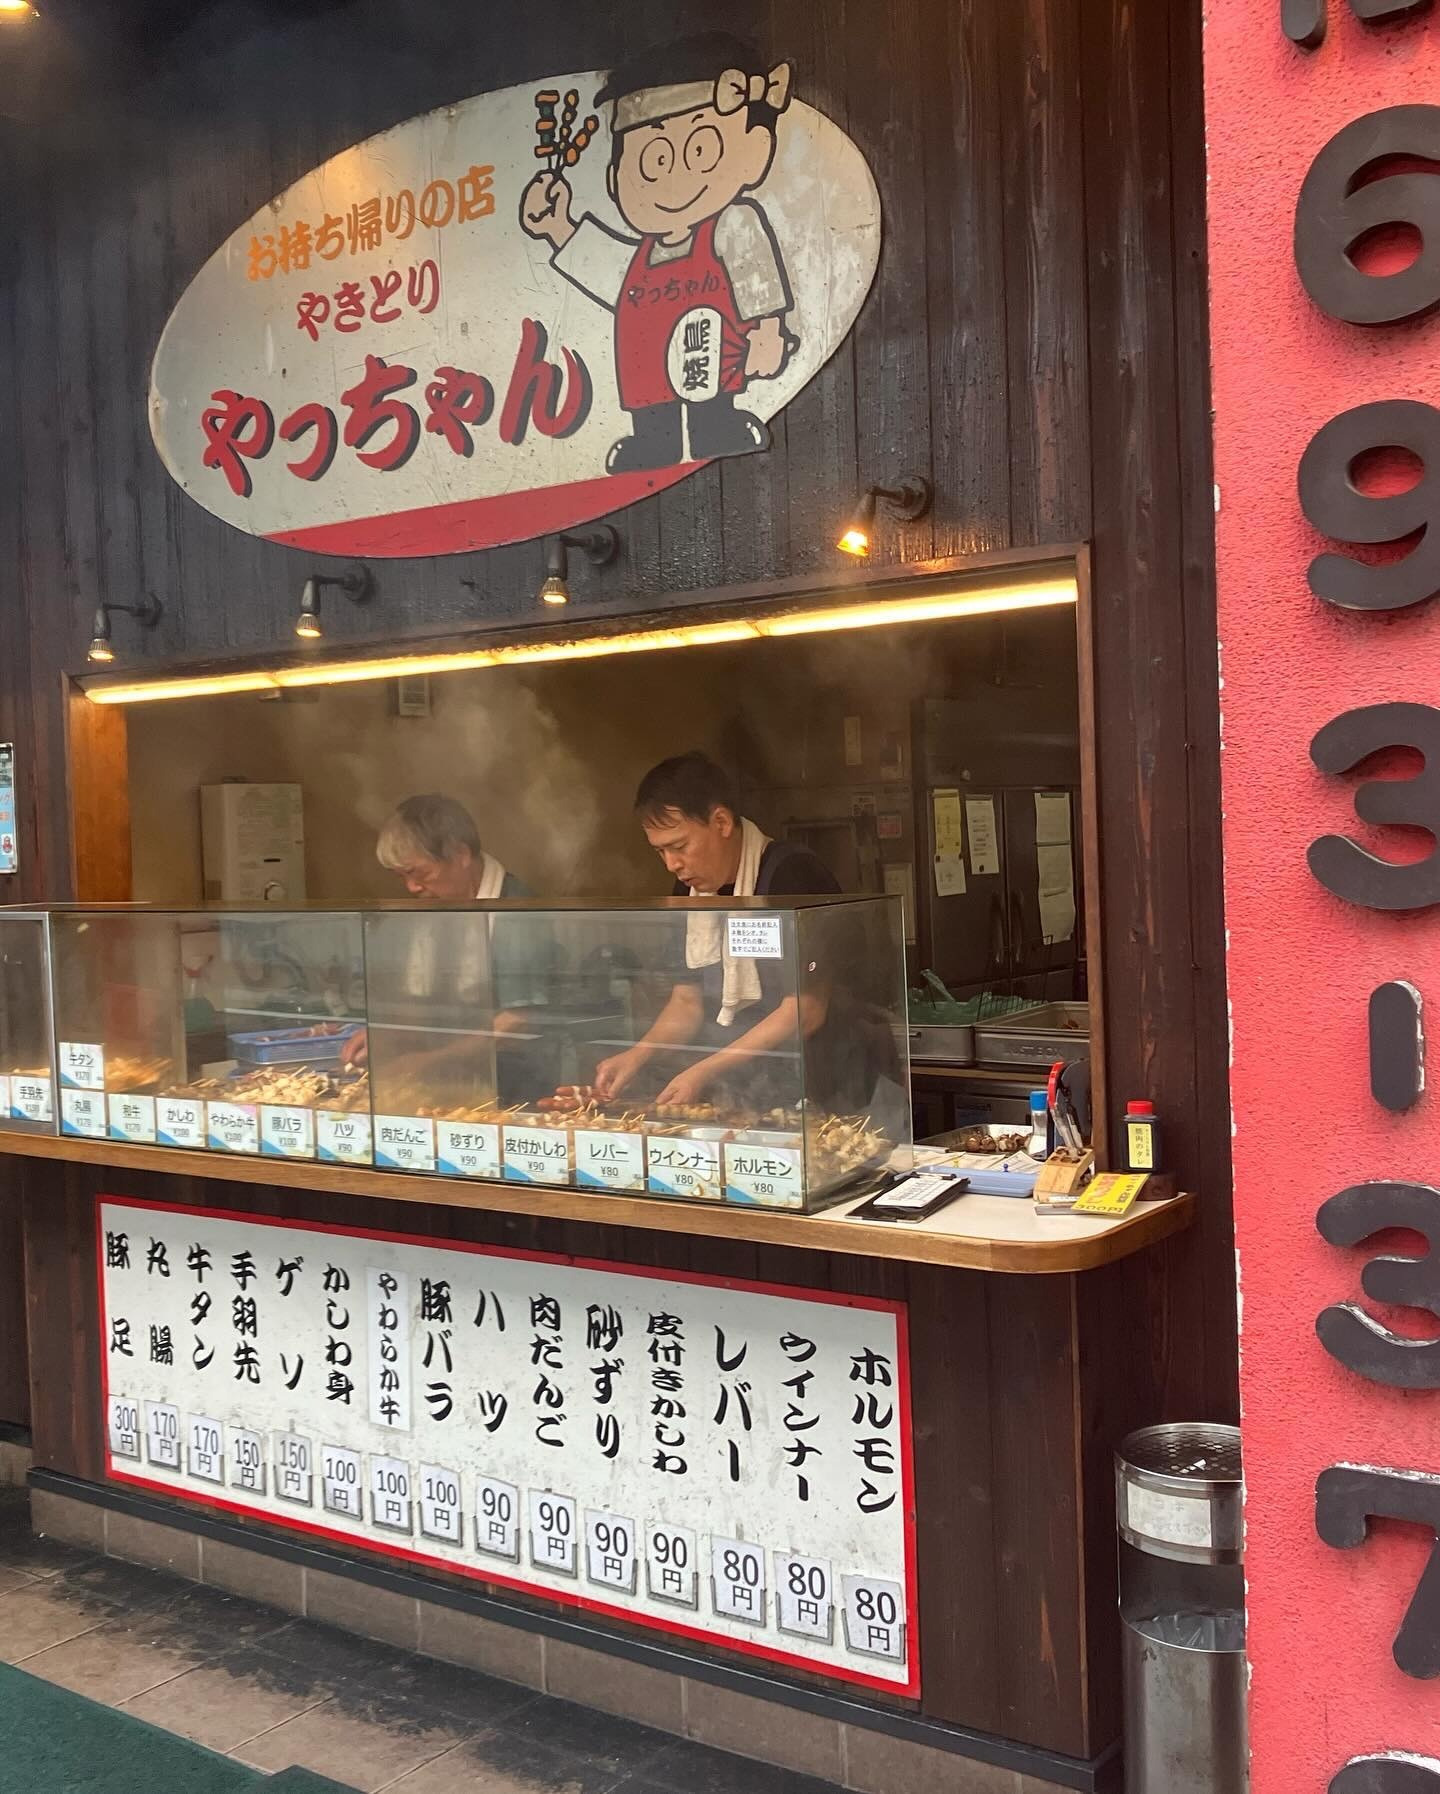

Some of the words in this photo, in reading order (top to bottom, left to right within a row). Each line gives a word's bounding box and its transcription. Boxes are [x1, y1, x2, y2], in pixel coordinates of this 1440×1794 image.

[245, 164, 496, 282] お持ち帰りの店
[295, 259, 441, 341] やきとり
[627, 270, 720, 308] やっちゃん
[201, 318, 593, 497] やっちゃん
[167, 1108, 194, 1122] かしわ
[271, 1116, 302, 1131] 豚バラ
[334, 1123, 355, 1137] ハツ
[337, 1143, 352, 1152] ¥90
[397, 1149, 412, 1158] ¥90
[449, 1133, 485, 1149] 砂ずり
[505, 1137, 567, 1157] 皮付かしわ
[589, 1143, 629, 1158] レバー
[460, 1155, 477, 1165] ¥90
[527, 1161, 545, 1171] ¥90
[600, 1166, 619, 1176] ¥80
[649, 1148, 718, 1167] ウインナー
[675, 1174, 694, 1184] ¥80
[733, 1157, 792, 1176] ホルモン
[754, 1182, 774, 1193] ¥80
[105, 1231, 134, 1357] 豚足
[146, 1237, 174, 1366] 丸腸
[186, 1242, 215, 1370] 牛タン
[230, 1250, 261, 1384] 手羽先
[275, 1256, 304, 1390] ゲソ
[322, 1263, 354, 1405] かしわ身
[376, 1272, 400, 1425] やわらか牛
[420, 1278, 453, 1421] 豚バラ
[473, 1288, 508, 1432] ハツ
[529, 1293, 565, 1448] 肉だんご
[585, 1303, 623, 1459] 砂ずり
[646, 1311, 688, 1475] 皮付きかしわ
[713, 1324, 752, 1482] レバー
[848, 1346, 897, 1514] ホルモン
